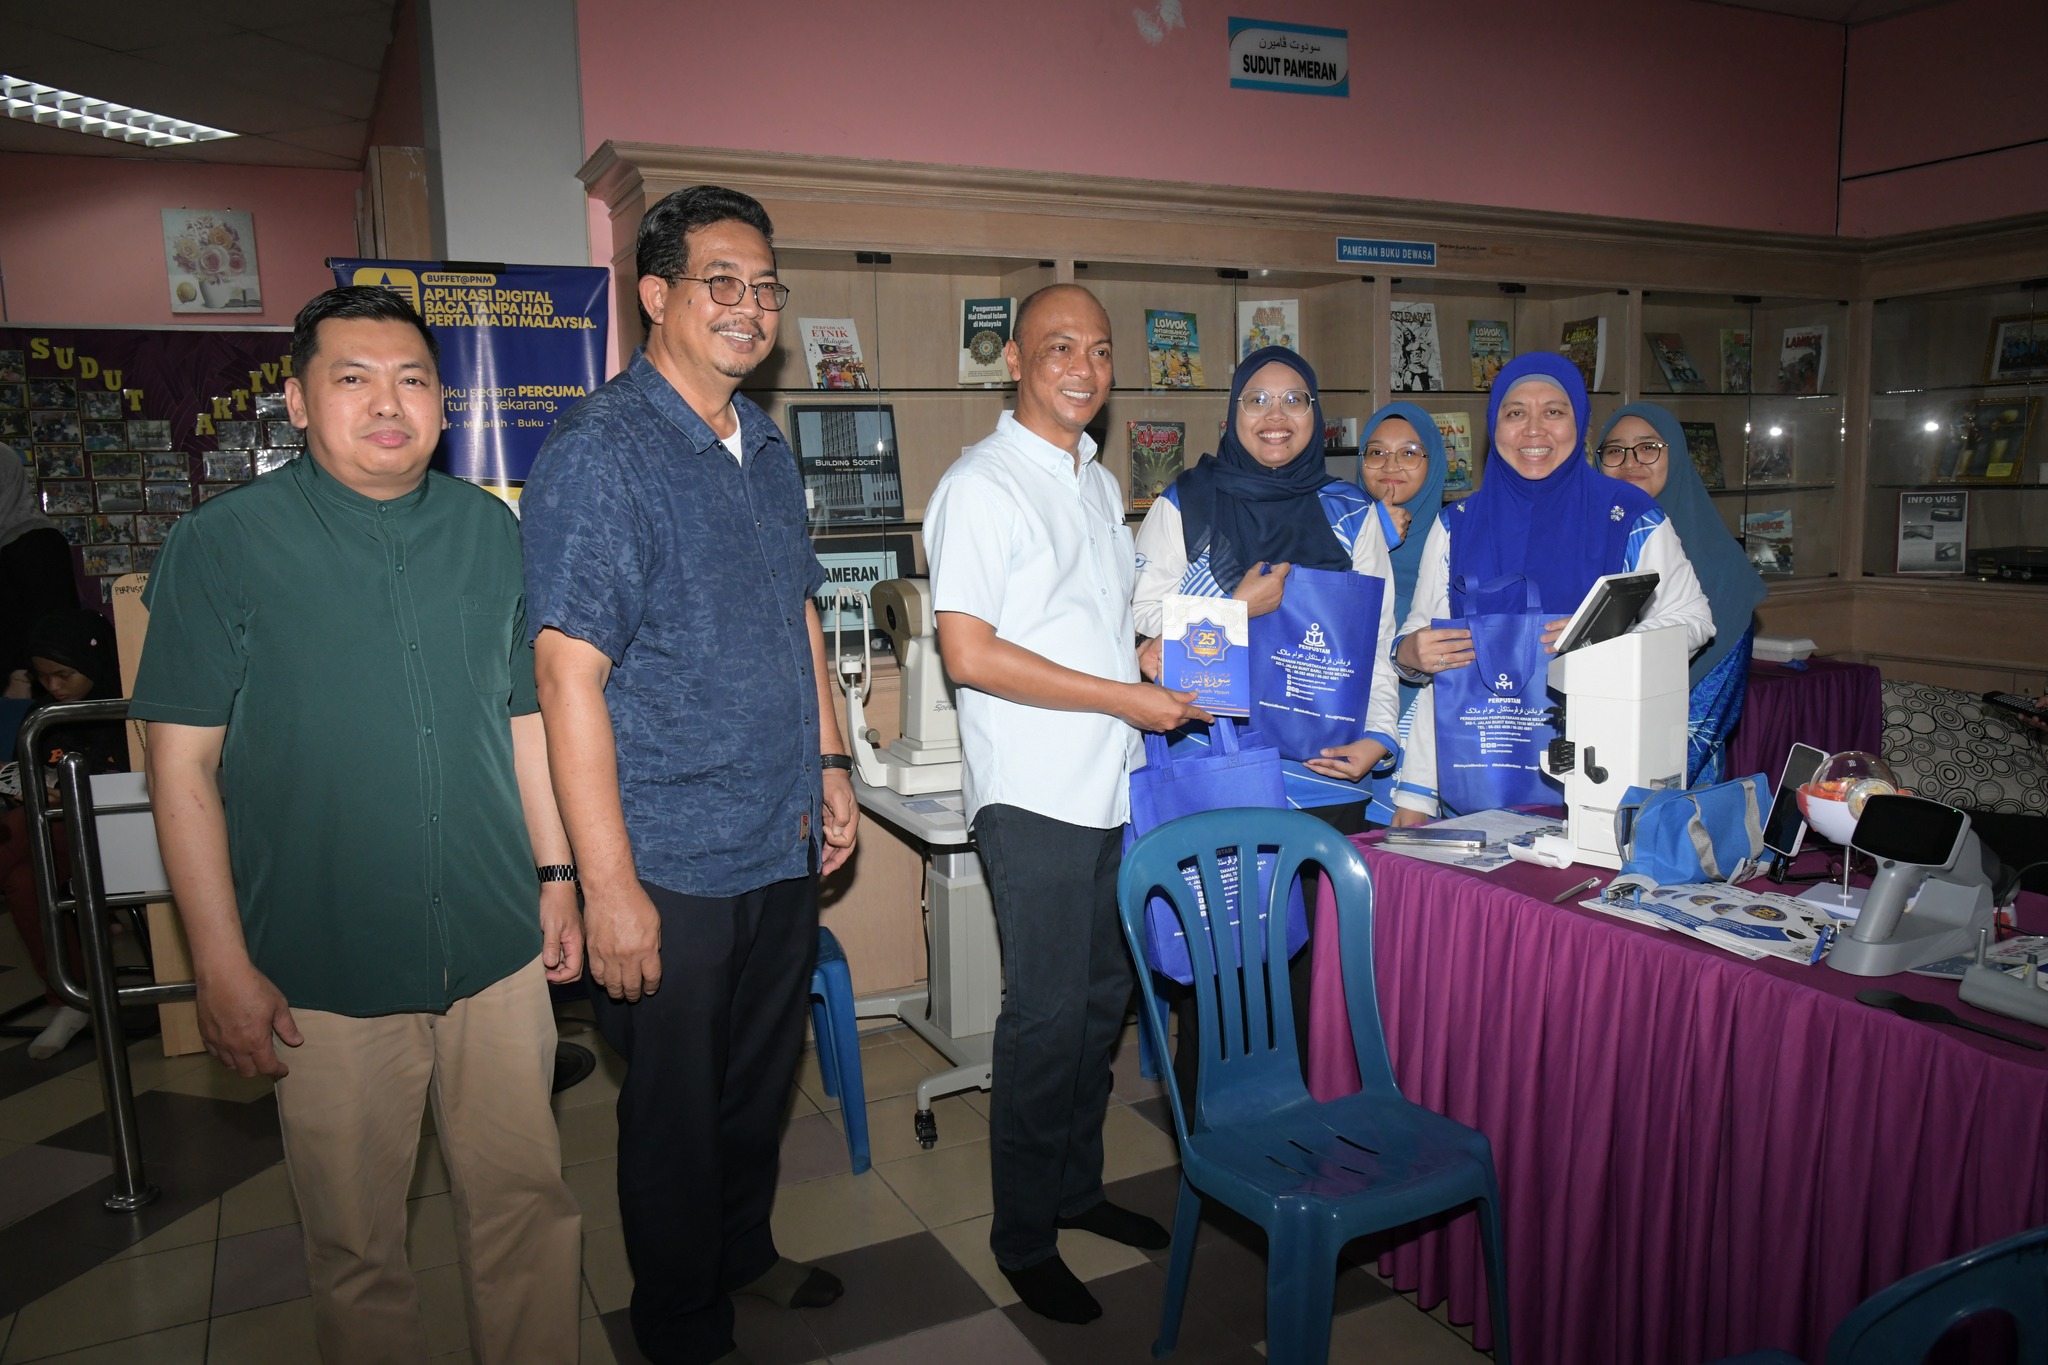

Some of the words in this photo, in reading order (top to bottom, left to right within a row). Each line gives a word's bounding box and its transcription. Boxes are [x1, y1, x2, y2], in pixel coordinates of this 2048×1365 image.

[1243, 54, 1281, 75] SUDUT
[1283, 58, 1337, 81] PAMERAN
[1342, 245, 1378, 257] PAMERAN
[1380, 247, 1400, 258] BUKU
[1402, 249, 1432, 261] DEWASA
[427, 275, 492, 284] BUFFET@PNM
[423, 288, 492, 302] APLIKASI
[495, 290, 553, 304] DIGITAL
[424, 301, 467, 314] BACA
[469, 302, 518, 315] TANPA
[522, 303, 554, 316] HAD
[972, 305, 1003, 313] Pengurusan
[425, 314, 500, 327] PERTAMA
[502, 315, 517, 327] DI
[519, 316, 597, 329] MALAYSIA.
[978, 320, 1002, 328] Malaysia
[811, 330, 848, 338] ETNIK
[30, 337, 144, 412] SUDUT
[194, 343, 294, 436] AKTIVI
[442, 386, 466, 399] uku
[470, 387, 516, 398] secara
[518, 385, 586, 397] PERCUMA
[447, 401, 489, 412] turun
[493, 399, 559, 413] sekarang.
[517, 418, 544, 427] Buku
[815, 459, 850, 467] BUILDING
[1907, 495, 1933, 504] INFO
[1934, 495, 1957, 503] VHS
[824, 566, 879, 583] AMERAN
[1197, 632, 1216, 646] 25
[1298, 644, 1331, 654] PERPUSTAM
